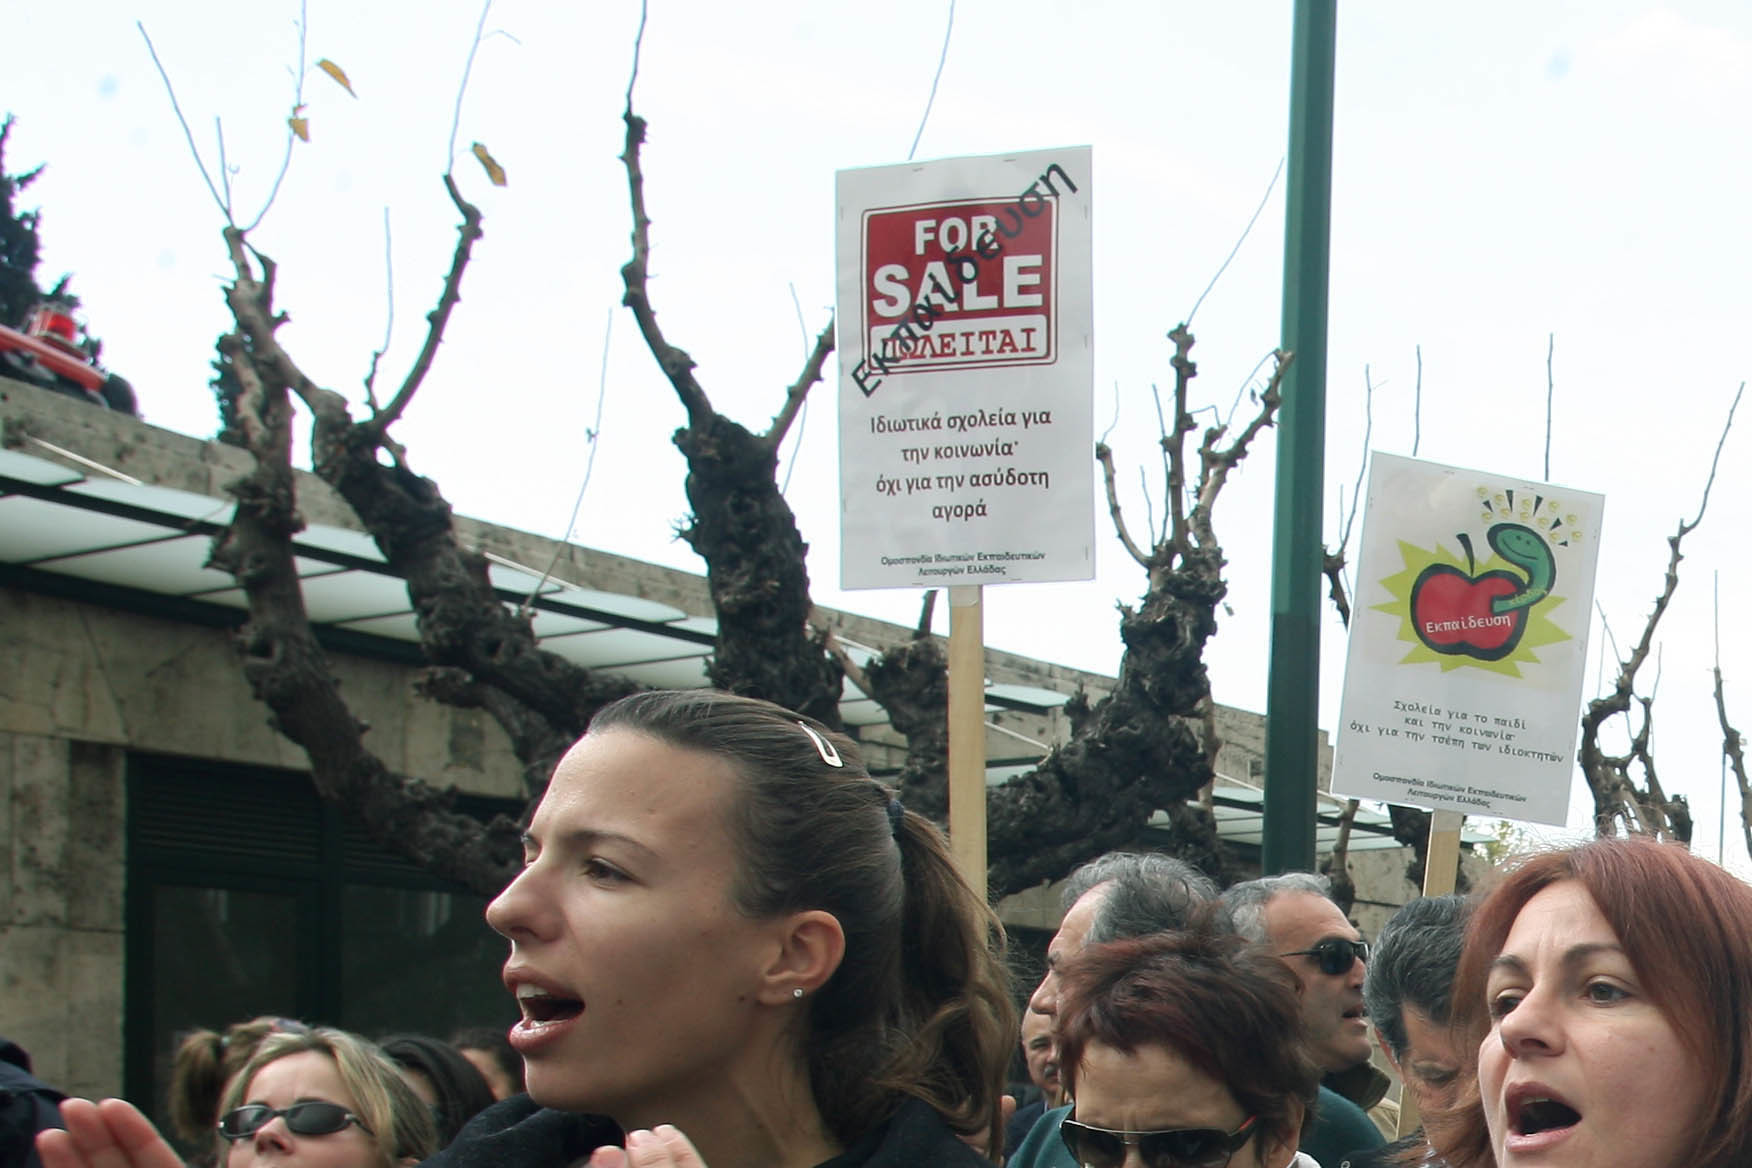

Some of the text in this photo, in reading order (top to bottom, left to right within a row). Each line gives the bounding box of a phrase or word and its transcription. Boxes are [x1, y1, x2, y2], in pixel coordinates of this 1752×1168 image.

[915, 215, 1001, 255] FOR
[872, 254, 1043, 318] SALE
[871, 408, 1052, 433] Ιδιωτικά σχολεία για
[901, 447, 929, 464] την
[876, 468, 1049, 495] όχι για την ασύδοτη
[932, 499, 987, 522] αγορά
[1426, 614, 1512, 633] Εκπαίδευση
[1393, 700, 1527, 730] Σχολεία για το παιδί
[1404, 717, 1424, 728] και
[1431, 720, 1452, 731] την
[1350, 719, 1564, 764] όχι για την τσέπη των ιδιοκτητών
